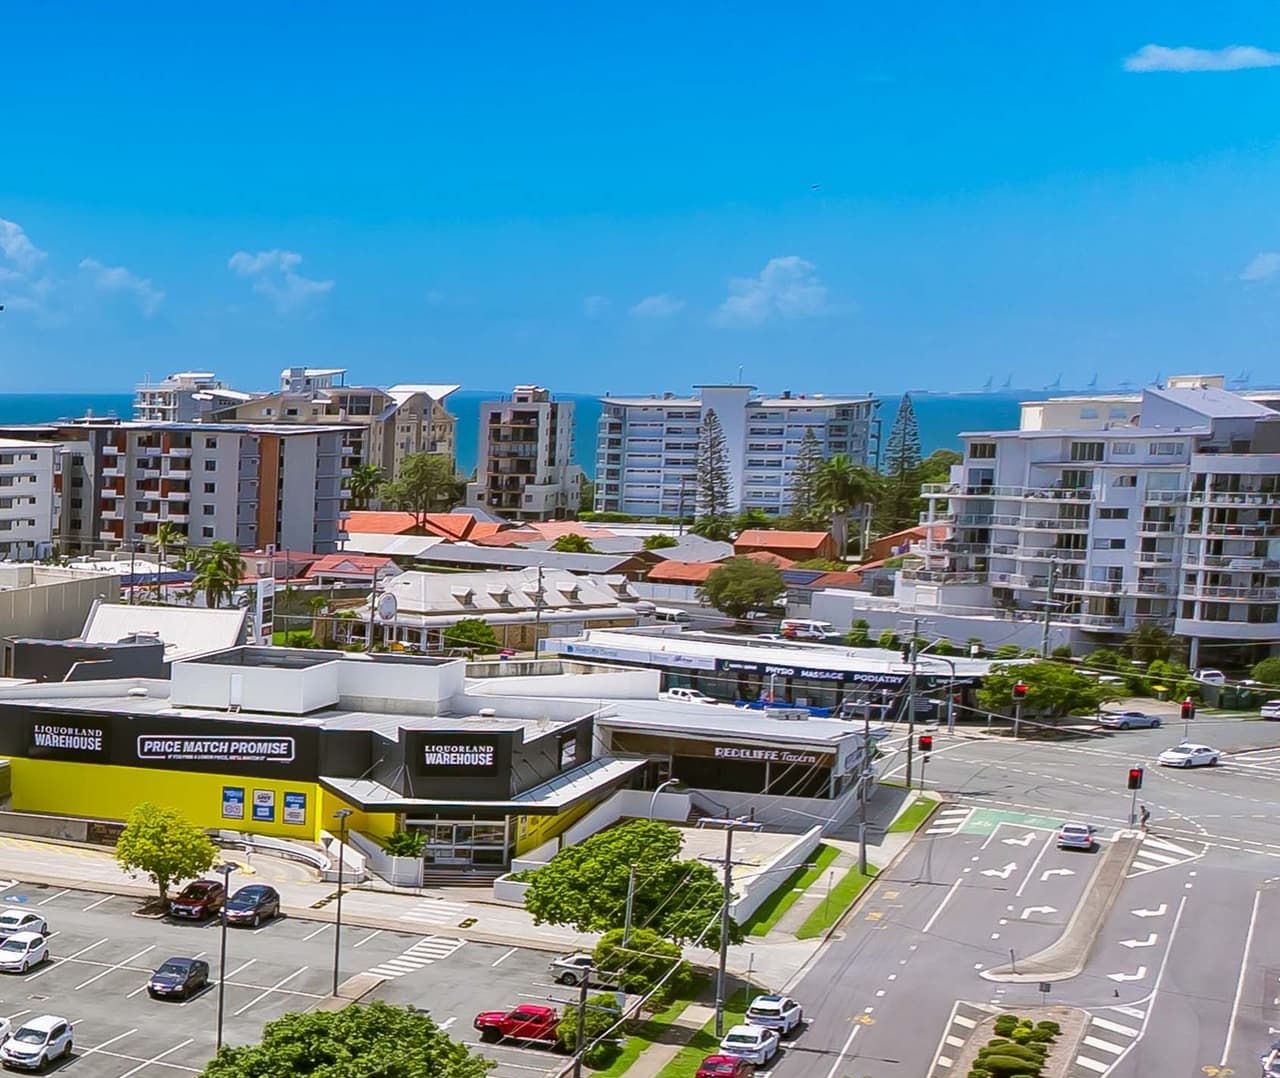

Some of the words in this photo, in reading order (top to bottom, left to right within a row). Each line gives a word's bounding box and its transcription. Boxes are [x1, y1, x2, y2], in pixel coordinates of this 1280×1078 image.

[765, 665, 794, 676] PHYSIO
[800, 669, 844, 680] MASSAGE
[853, 673, 904, 684] PODIATRY
[34, 724, 103, 737] LIQUORLAND
[35, 734, 102, 751] WAREHOUSE
[143, 740, 182, 754] PRICE
[183, 741, 228, 754] MATCH
[229, 741, 288, 755] PROMISE
[424, 745, 494, 753] LIQUORLAND
[425, 753, 494, 766] WAREHOUSE
[714, 747, 780, 761] REDCLIFFE
